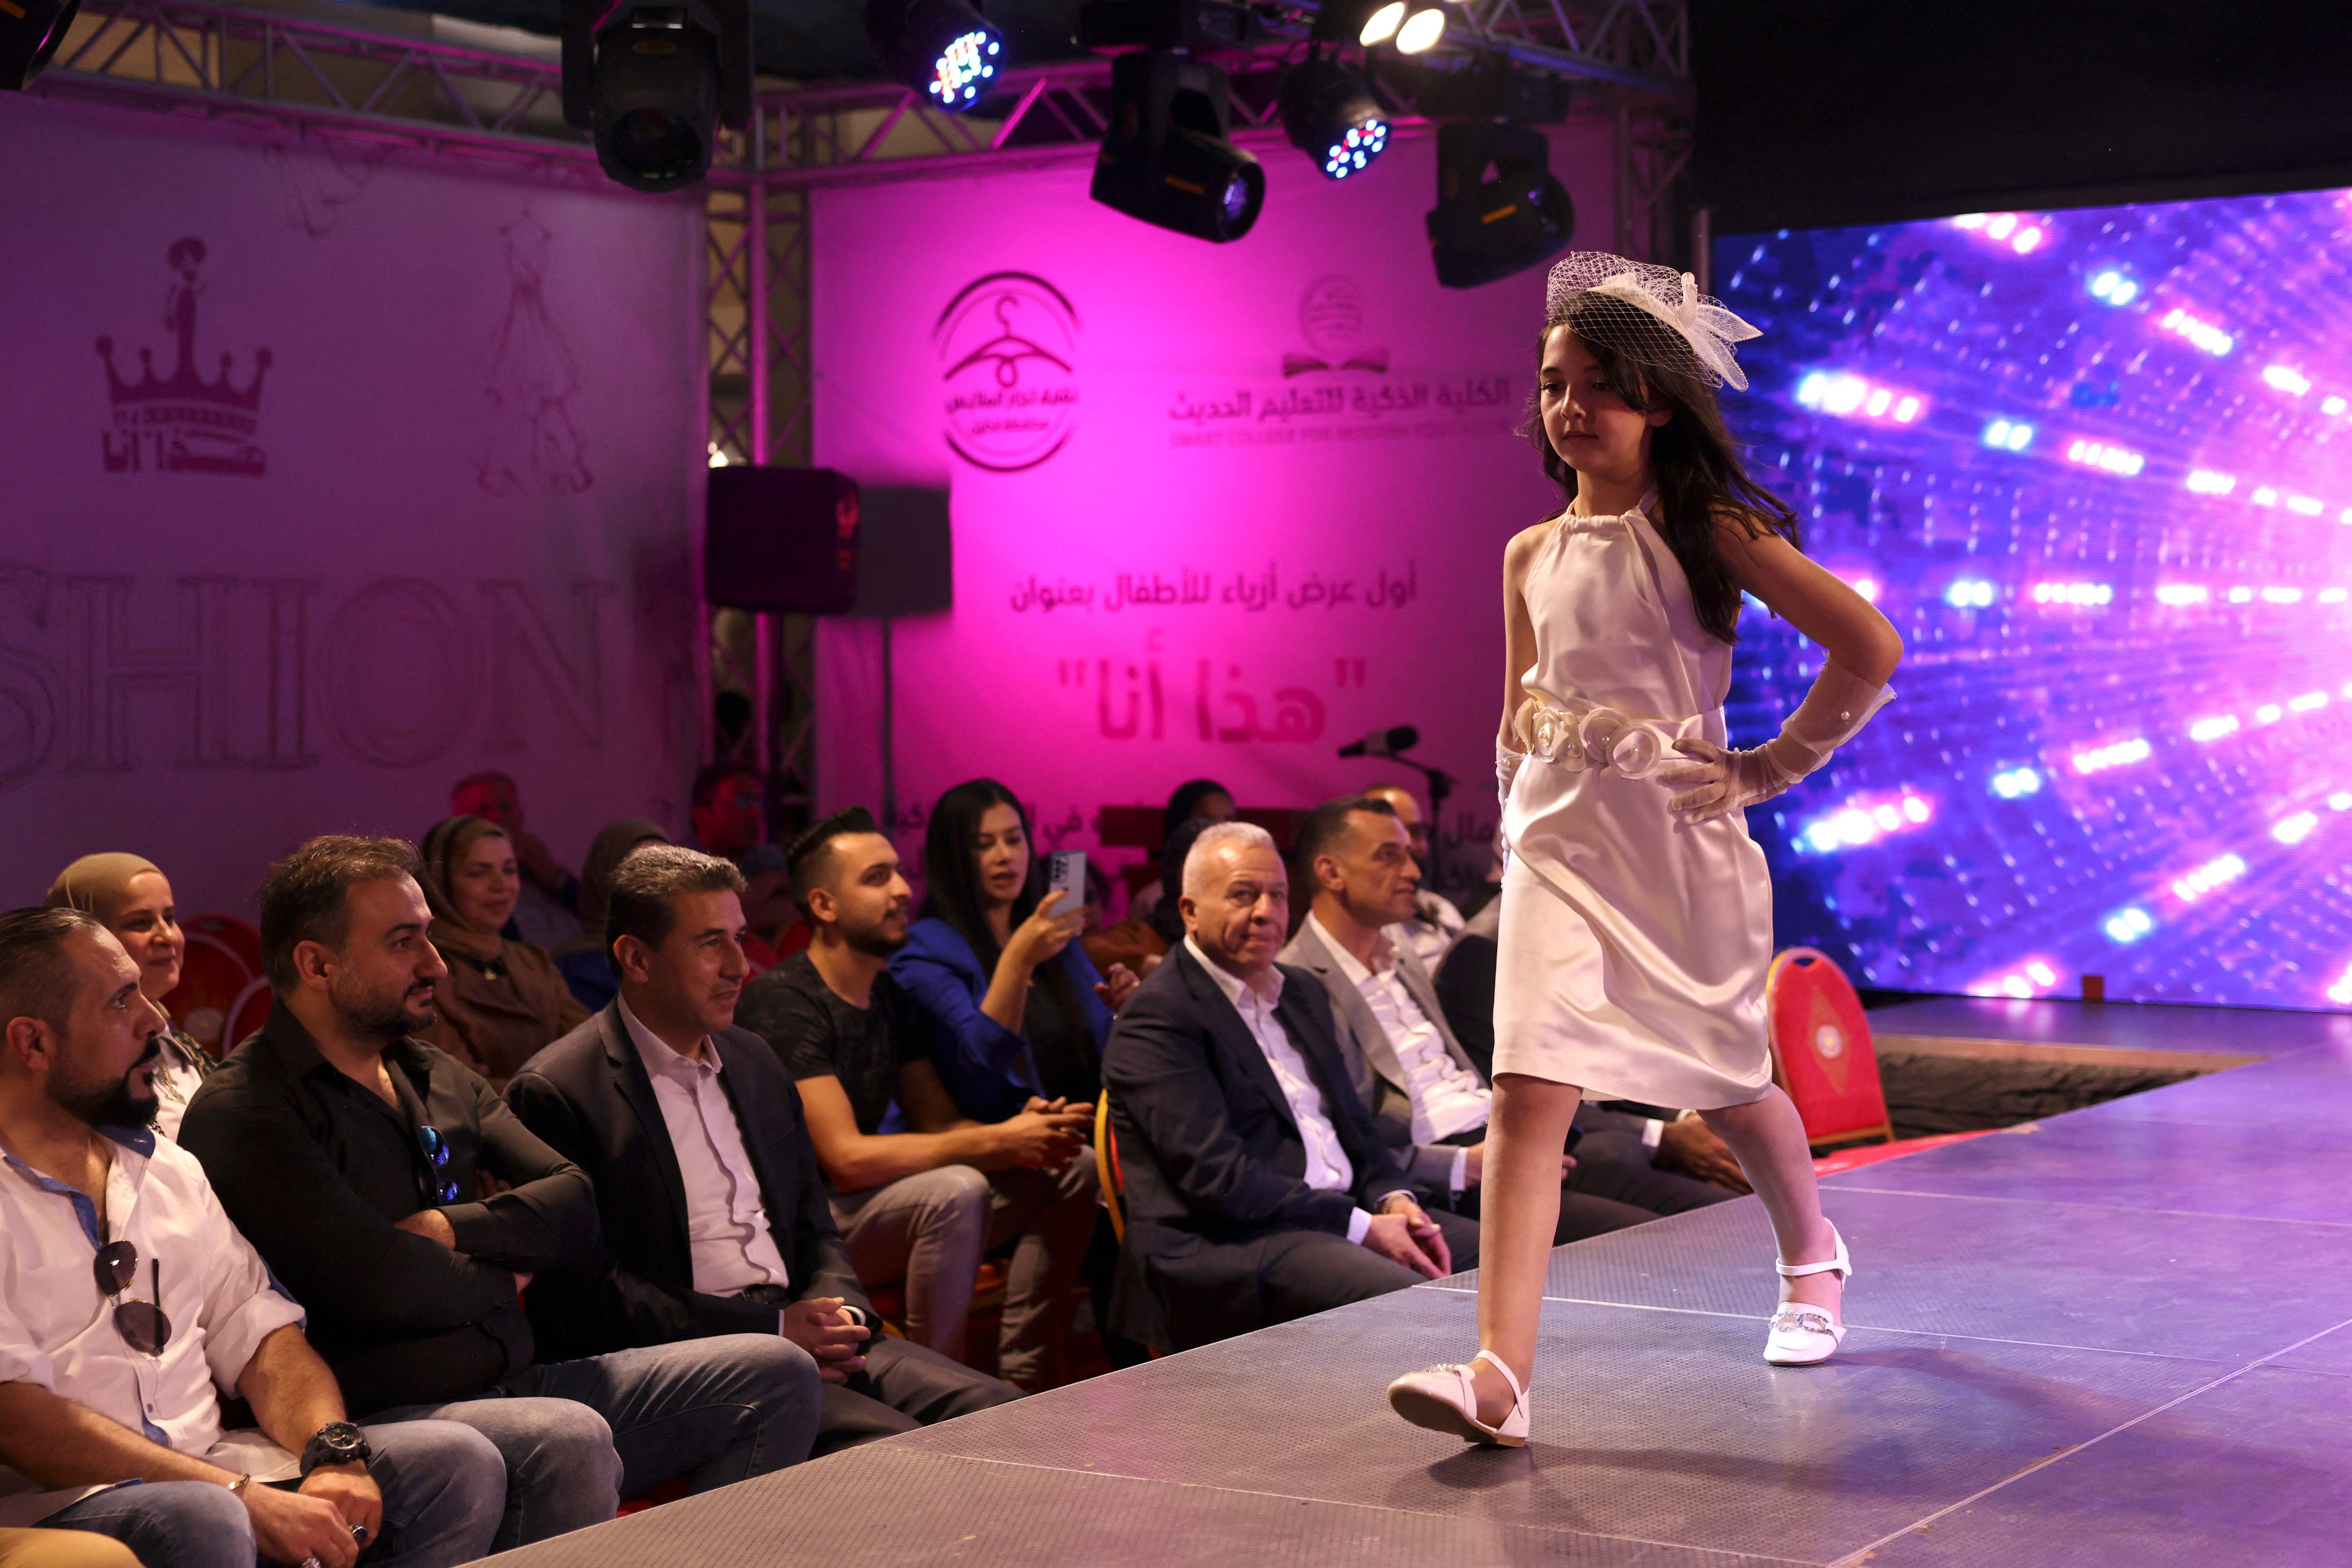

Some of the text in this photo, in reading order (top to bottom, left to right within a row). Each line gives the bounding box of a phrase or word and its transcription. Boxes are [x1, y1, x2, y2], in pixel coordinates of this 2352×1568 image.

[1168, 390, 1251, 424] الحديث
[1259, 384, 1344, 423] للتعليم
[1168, 430, 1223, 449] SMART
[1010, 557, 1418, 614] أول عرض أزياء للأطفال بعنوان
